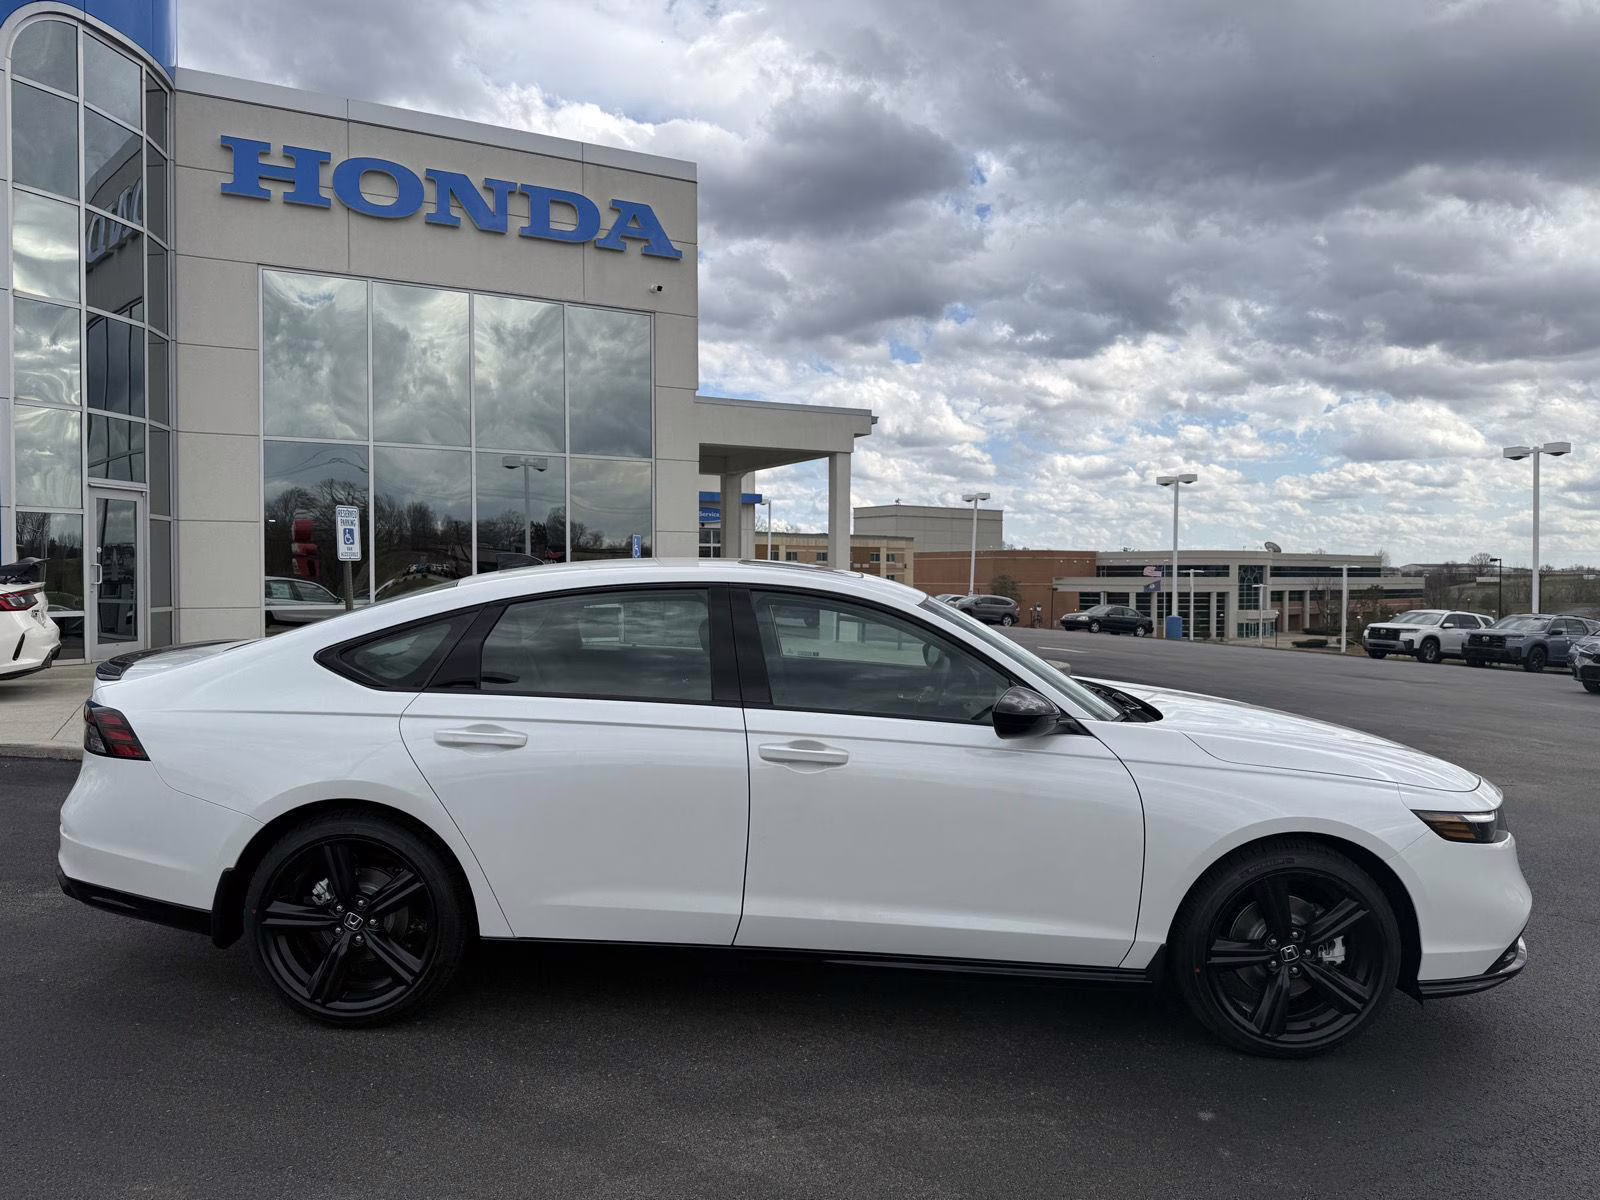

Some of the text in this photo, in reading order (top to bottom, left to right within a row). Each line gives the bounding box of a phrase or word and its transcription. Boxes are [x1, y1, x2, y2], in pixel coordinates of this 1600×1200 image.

[220, 134, 683, 260] HONDA
[338, 509, 357, 518] RESERVED
[340, 518, 356, 527] PARKING
